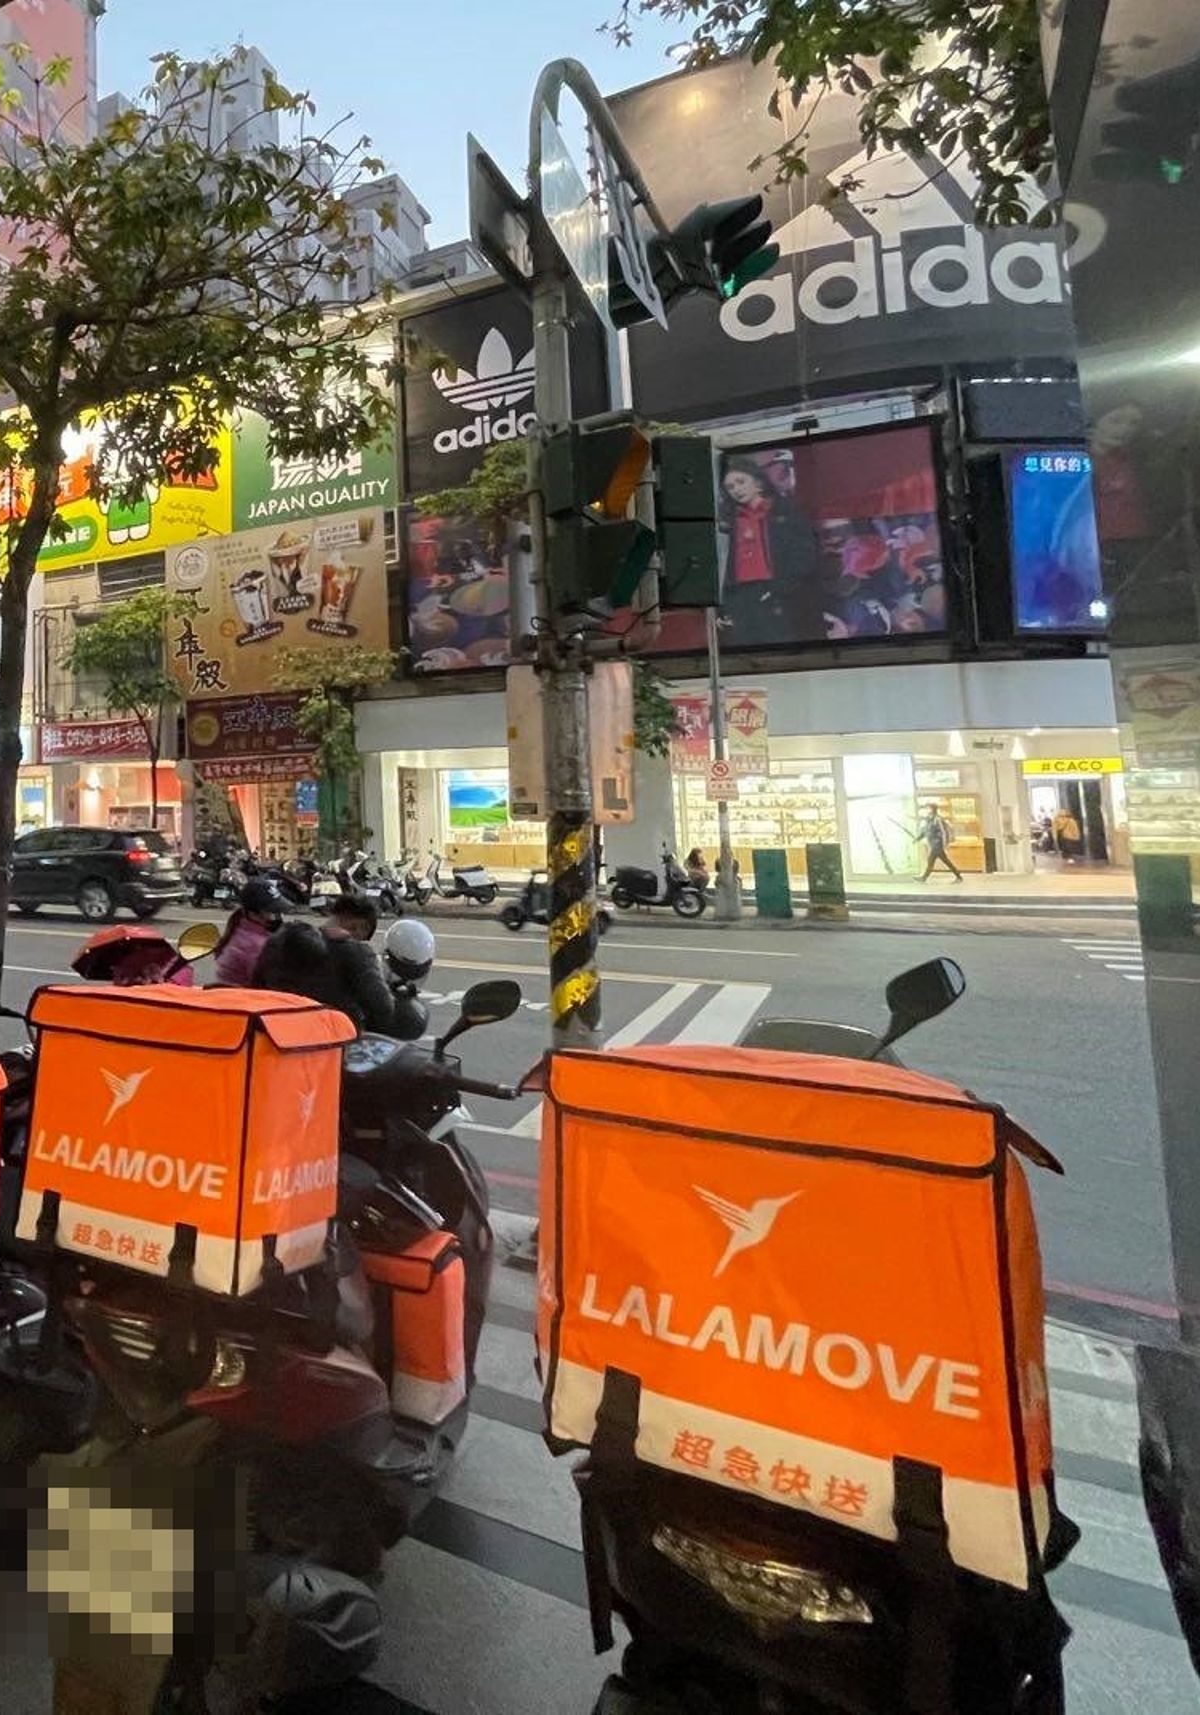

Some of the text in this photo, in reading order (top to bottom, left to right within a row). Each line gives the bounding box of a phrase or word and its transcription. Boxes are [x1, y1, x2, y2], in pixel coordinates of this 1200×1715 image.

[720, 223, 1072, 343] adida
[433, 409, 537, 454] adida
[248, 479, 389, 519] JAPAN QUALITY
[32, 1129, 228, 1200] LALAMOVE
[72, 1222, 165, 1266] 超急快送
[579, 1274, 981, 1421] LALAMOVE
[671, 1429, 869, 1517] 超急快送
